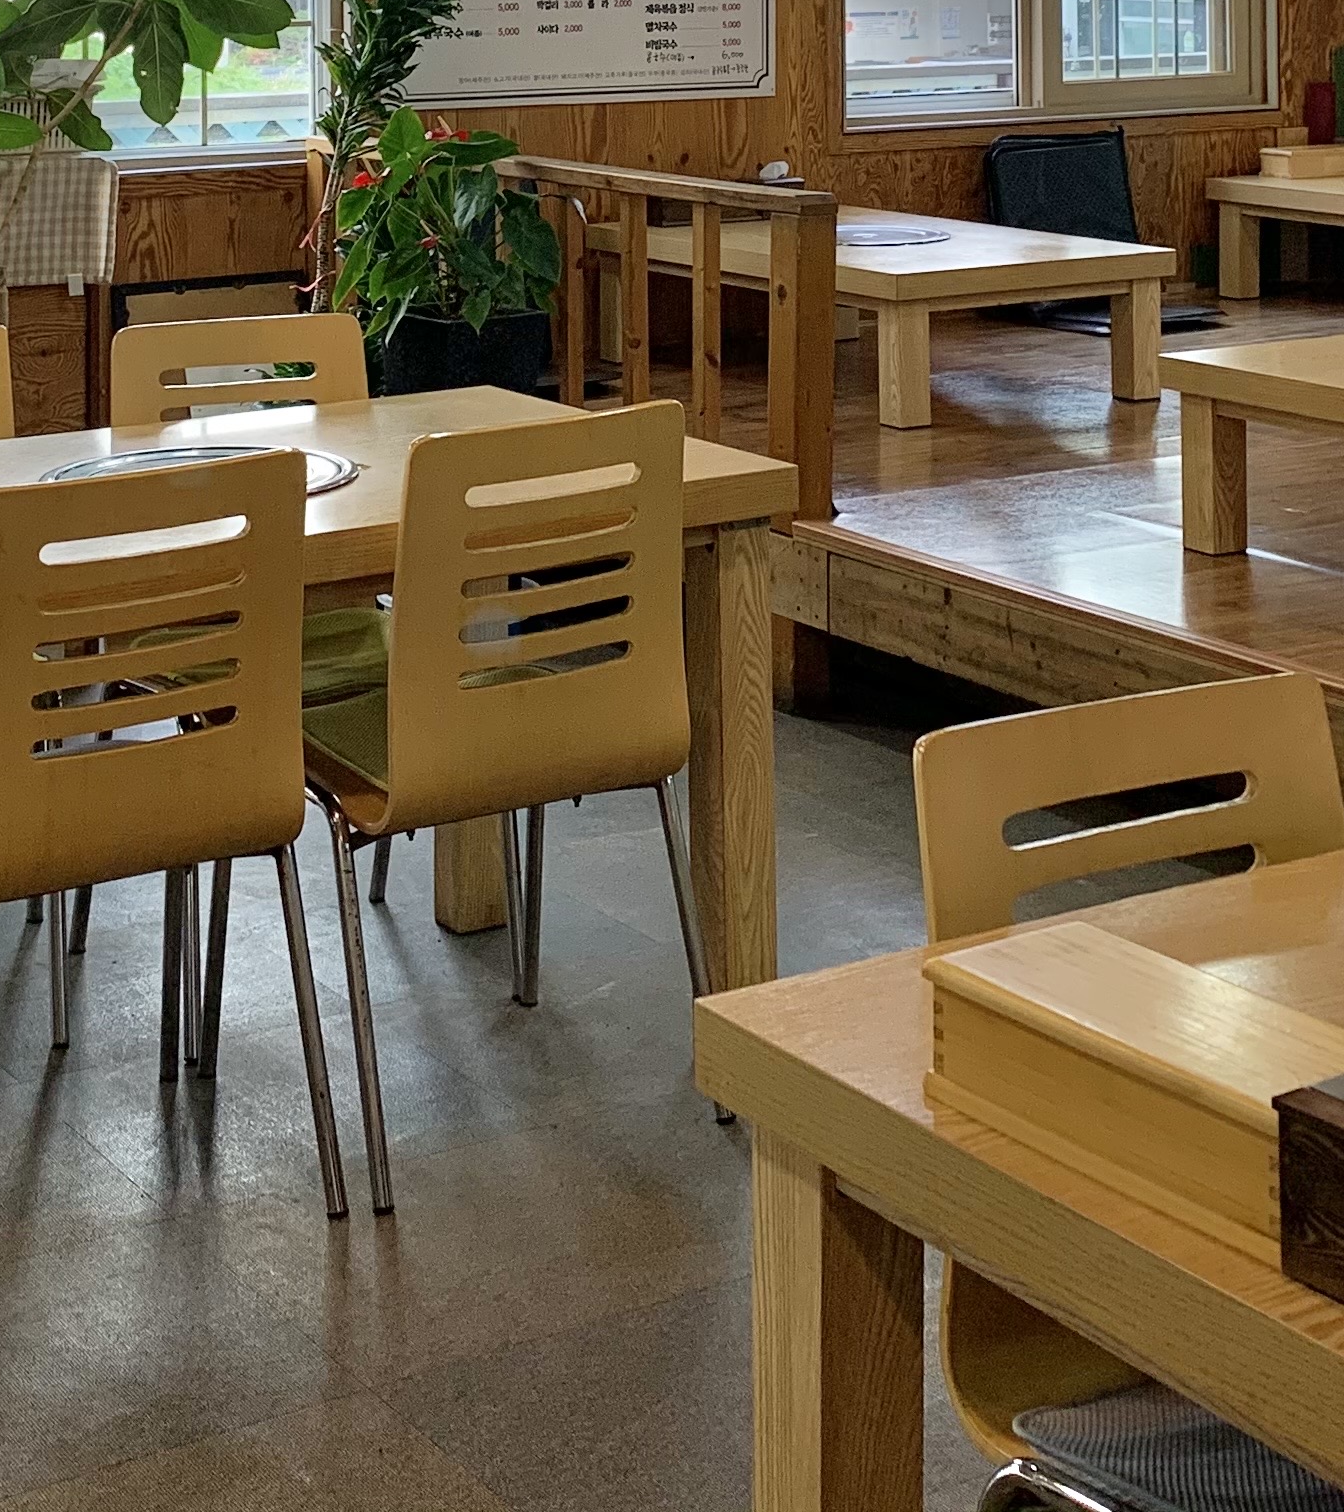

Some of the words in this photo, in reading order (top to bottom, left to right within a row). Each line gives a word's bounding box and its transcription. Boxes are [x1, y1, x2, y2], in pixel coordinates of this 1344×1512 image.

[497, 2, 520, 12] 5,000
[536, 0, 560, 10] 막걸리
[563, 0, 583, 9] 3,000
[613, 0, 633, 8] 2,000
[721, 2, 742, 12] 8,000
[537, 24, 560, 35] 사이다
[563, 24, 584, 34] 2,000
[721, 20, 742, 30] 5,000
[497, 26, 521, 37] 5,000
[721, 37, 742, 48] 5,000
